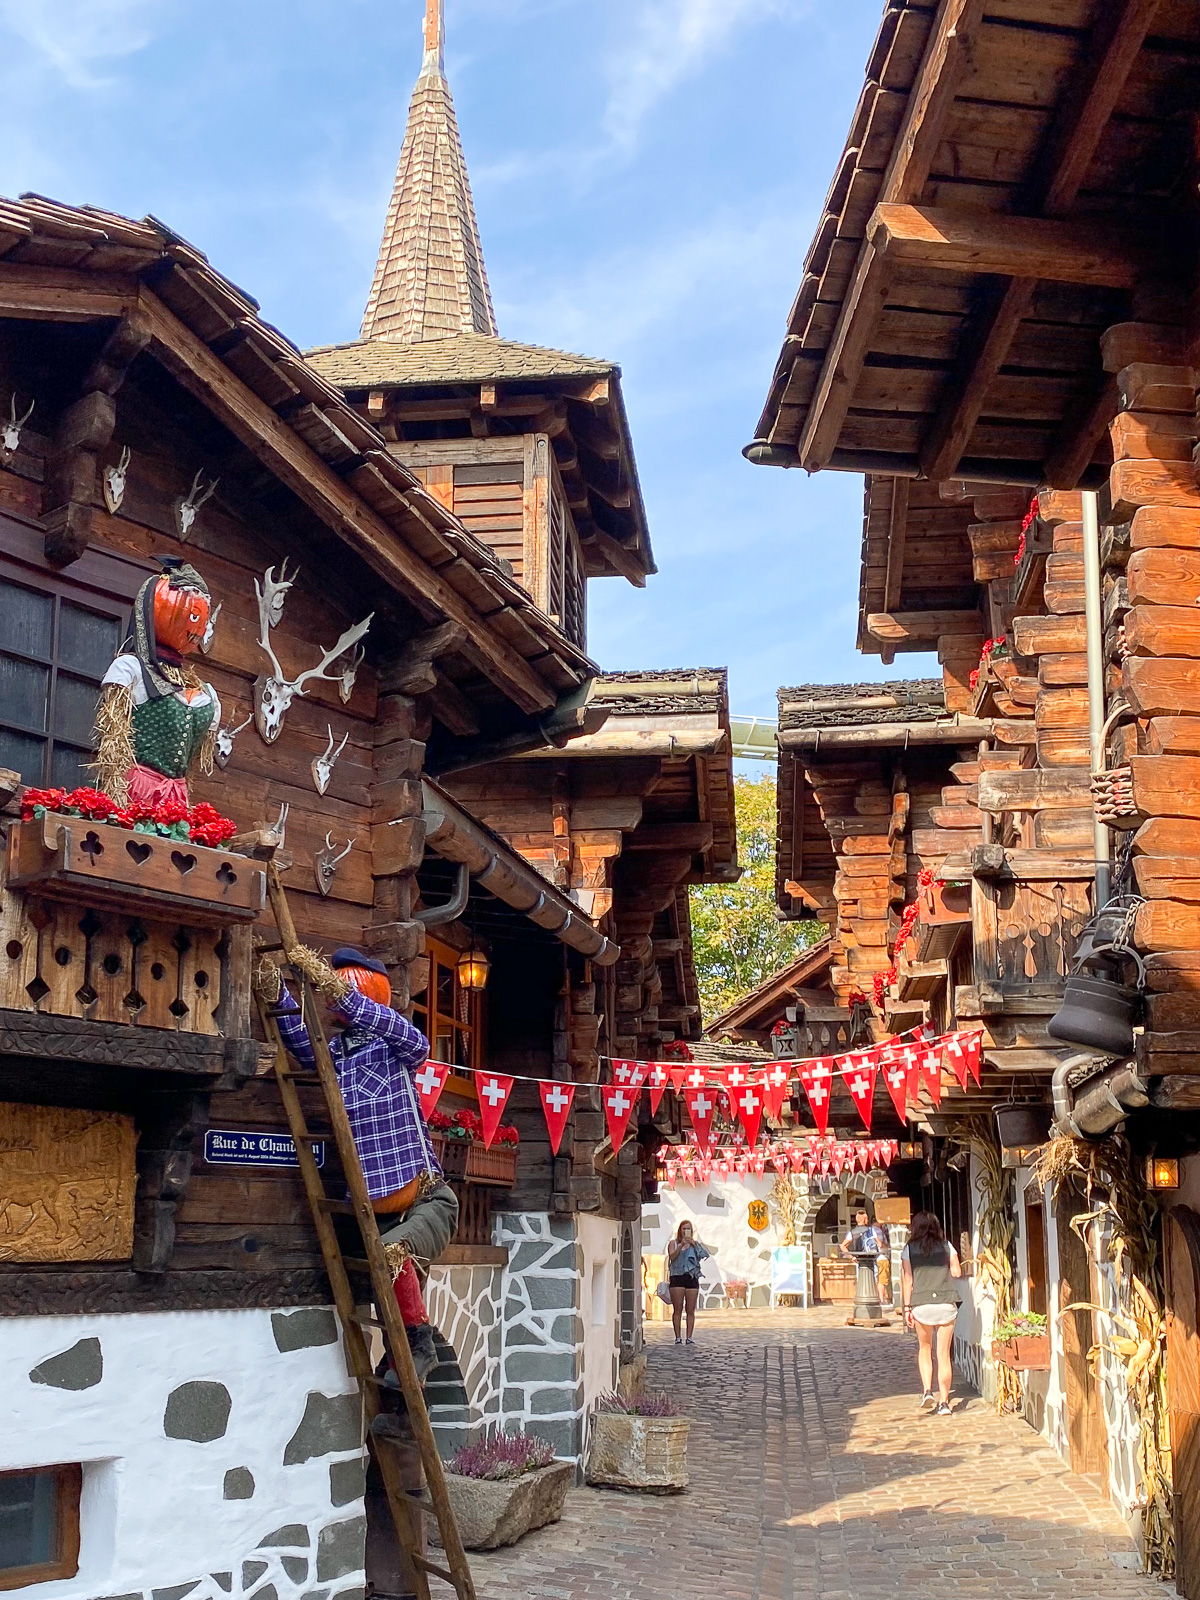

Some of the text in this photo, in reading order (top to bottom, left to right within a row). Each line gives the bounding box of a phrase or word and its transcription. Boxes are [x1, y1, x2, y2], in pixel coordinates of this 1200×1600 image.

[212, 1135, 319, 1154] Rue de Chandn
[874, 1178, 887, 1191] RAC
